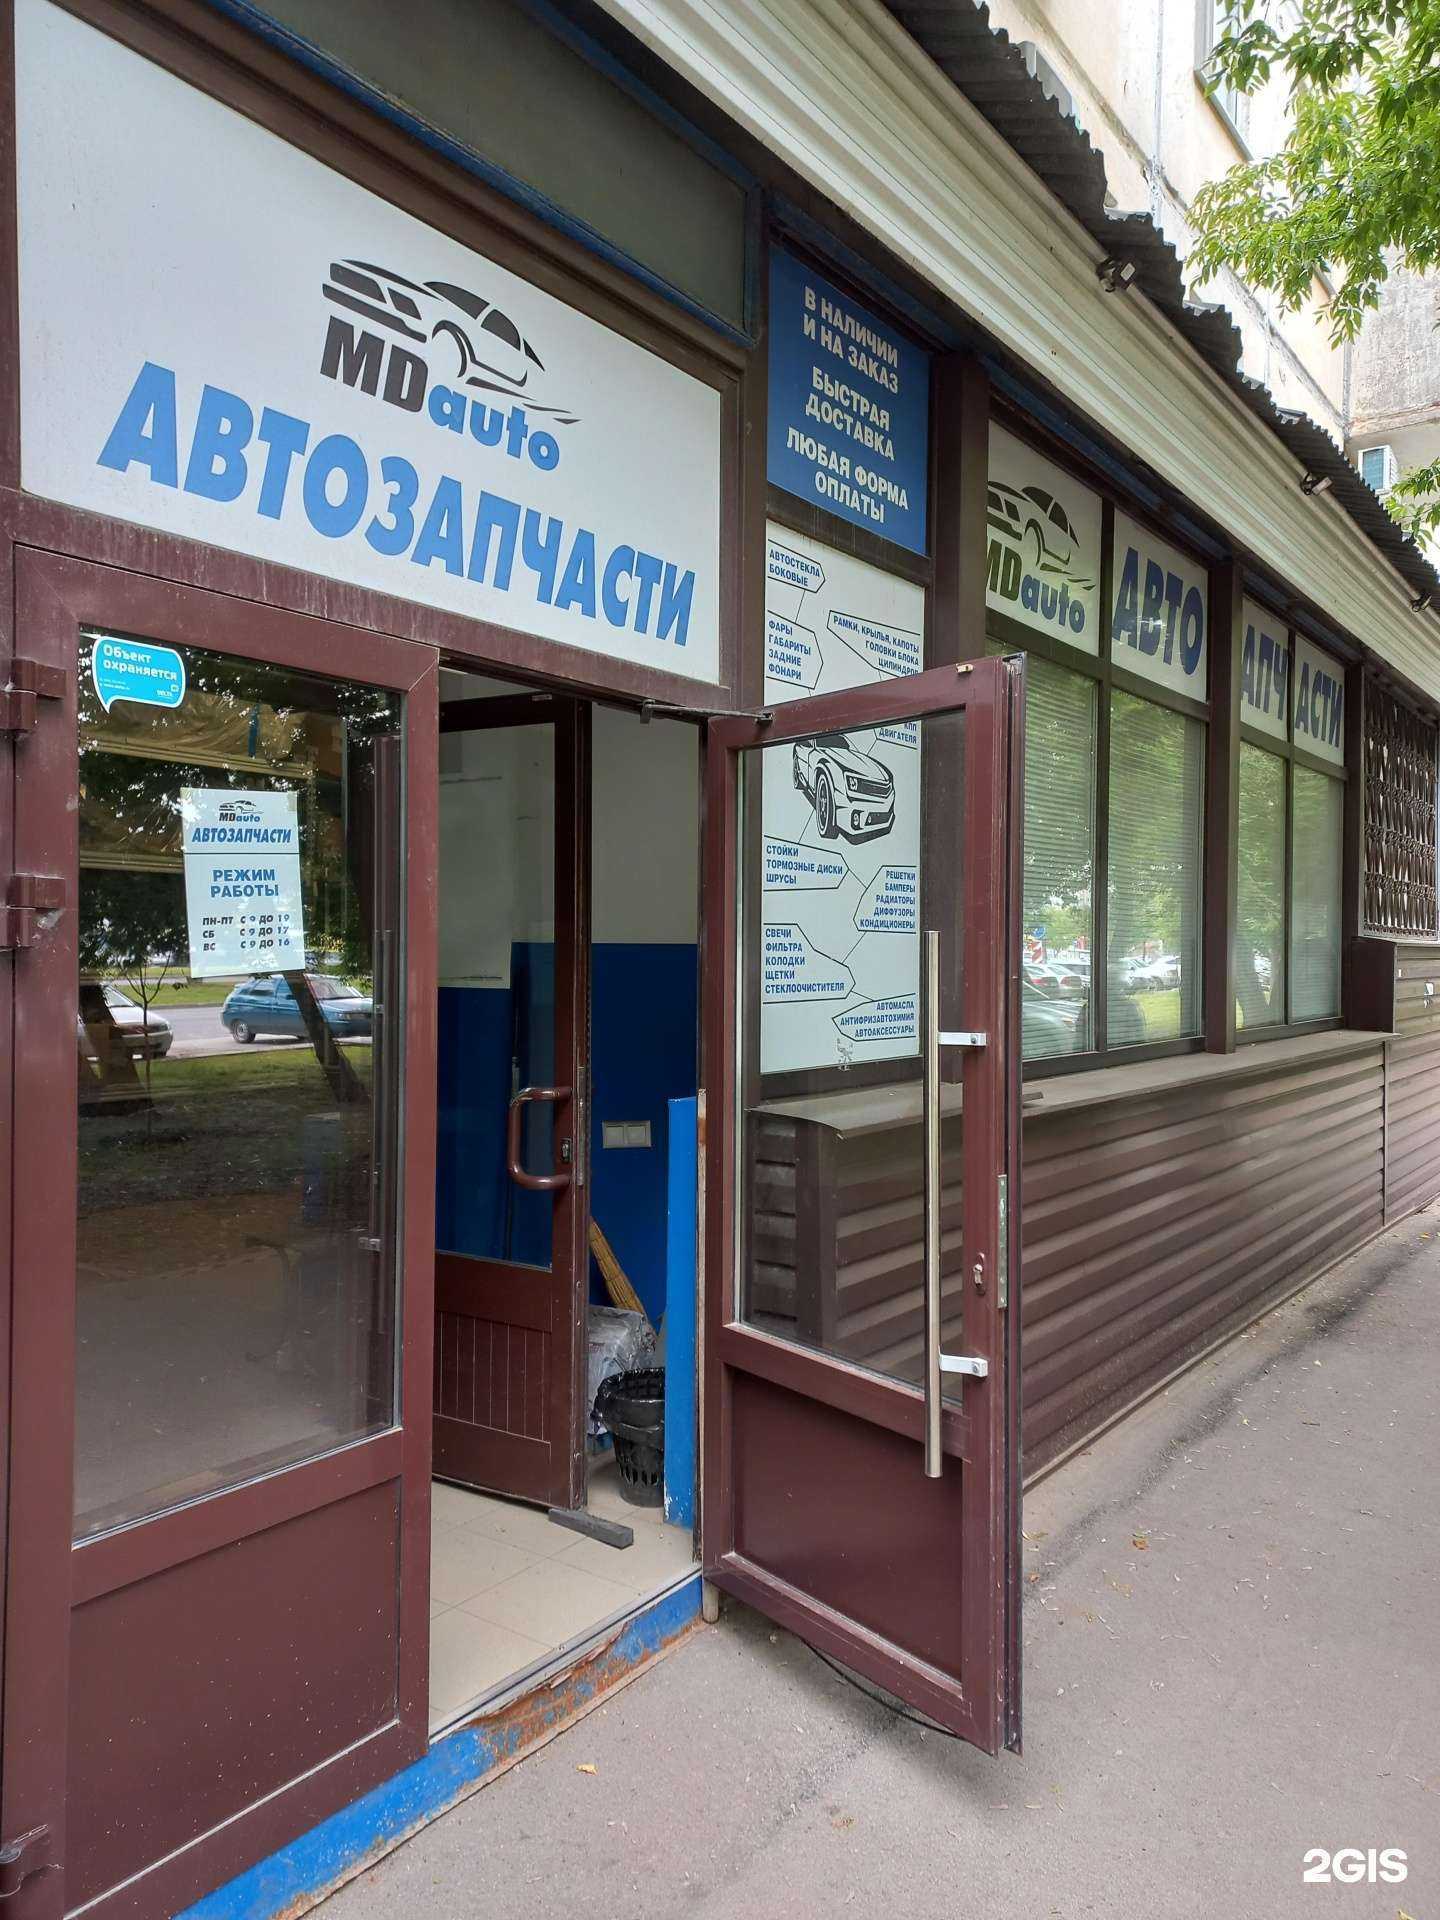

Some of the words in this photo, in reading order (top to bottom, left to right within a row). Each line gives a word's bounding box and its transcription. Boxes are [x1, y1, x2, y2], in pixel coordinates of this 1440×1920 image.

[805, 286, 816, 311] В
[821, 297, 899, 369] НАЛИЧИИ
[803, 313, 816, 340] И
[821, 322, 844, 359] НА
[848, 345, 899, 394] ЗАКАЗ
[320, 315, 560, 471] MDauto
[812, 366, 890, 432] БЫСТРАЯ
[805, 393, 895, 462] ДОСТАВКА
[786, 427, 850, 479] ЛЮБАЯ
[854, 464, 909, 510] ФОРМА
[97, 361, 696, 647] АВТОЗАПЧАСТИ
[814, 471, 885, 524] ОПЛАТЫ
[769, 549, 820, 577] АВТОСТЕКЛА
[769, 564, 808, 587] БОКОВЫЕ
[768, 619, 793, 636] ФАРЫ
[833, 615, 860, 634] РАМКИ,
[861, 625, 892, 645] КРЫЛЬЯ,
[892, 637, 920, 653] КАПОТЫ
[768, 634, 811, 656] ГАБАРИТЫ
[1112, 545, 1203, 676] АВТО
[1294, 661, 1343, 748] АСТИ
[103, 644, 152, 664] Объект
[768, 649, 801, 666] ЗАДНИЕ
[865, 640, 897, 658] ГОЛОВКИ
[898, 651, 919, 667] БЛОКА
[103, 660, 177, 681] охраняется
[768, 664, 801, 681] ФОНАРИ
[879, 727, 917, 744] ДВИГАТЕЛЯ
[219, 811, 261, 823] MDauto
[192, 827, 292, 843] АВТОЗАПЧАСТИ
[766, 844, 799, 857] СТОЙКИ
[766, 859, 815, 872] ТОРМОЗНЫЕ
[816, 863, 843, 875] ДИСКИ
[212, 869, 275, 882] РЕЖИМ
[766, 873, 797, 884] ШРУСЫ
[886, 870, 916, 881] РЕШЕТКИ
[210, 884, 279, 898] РАБОТЫ
[885, 883, 915, 893] БАМПЕРЫ
[876, 894, 915, 905] РАДИАТОРЫ
[202, 916, 234, 926] ПН-ПТ
[259, 914, 274, 925] ДО
[874, 907, 915, 917] ДИФФУЗОРЫ
[202, 930, 215, 938] СБ
[249, 928, 255, 936] 9
[258, 927, 273, 937] ДО
[277, 926, 289, 934] 17
[860, 919, 915, 930] КОНДИЦИОНЕРЫ
[765, 928, 792, 938] СВЕЧИ
[203, 942, 216, 951] ВС
[249, 940, 256, 948] 9
[259, 939, 274, 949] ДО
[278, 938, 290, 946] 16
[765, 942, 803, 952] ФИЛЬТРА
[765, 956, 805, 967] КОЛОДКИ
[765, 970, 795, 981] ЩЕТКИ
[765, 982, 845, 994] СТЕКЛООЧИСТИТЕЛЯ
[876, 1001, 914, 1010] АВТОМАСЛА
[855, 1025, 914, 1038] АВТОАКСЕССУАРЫ
